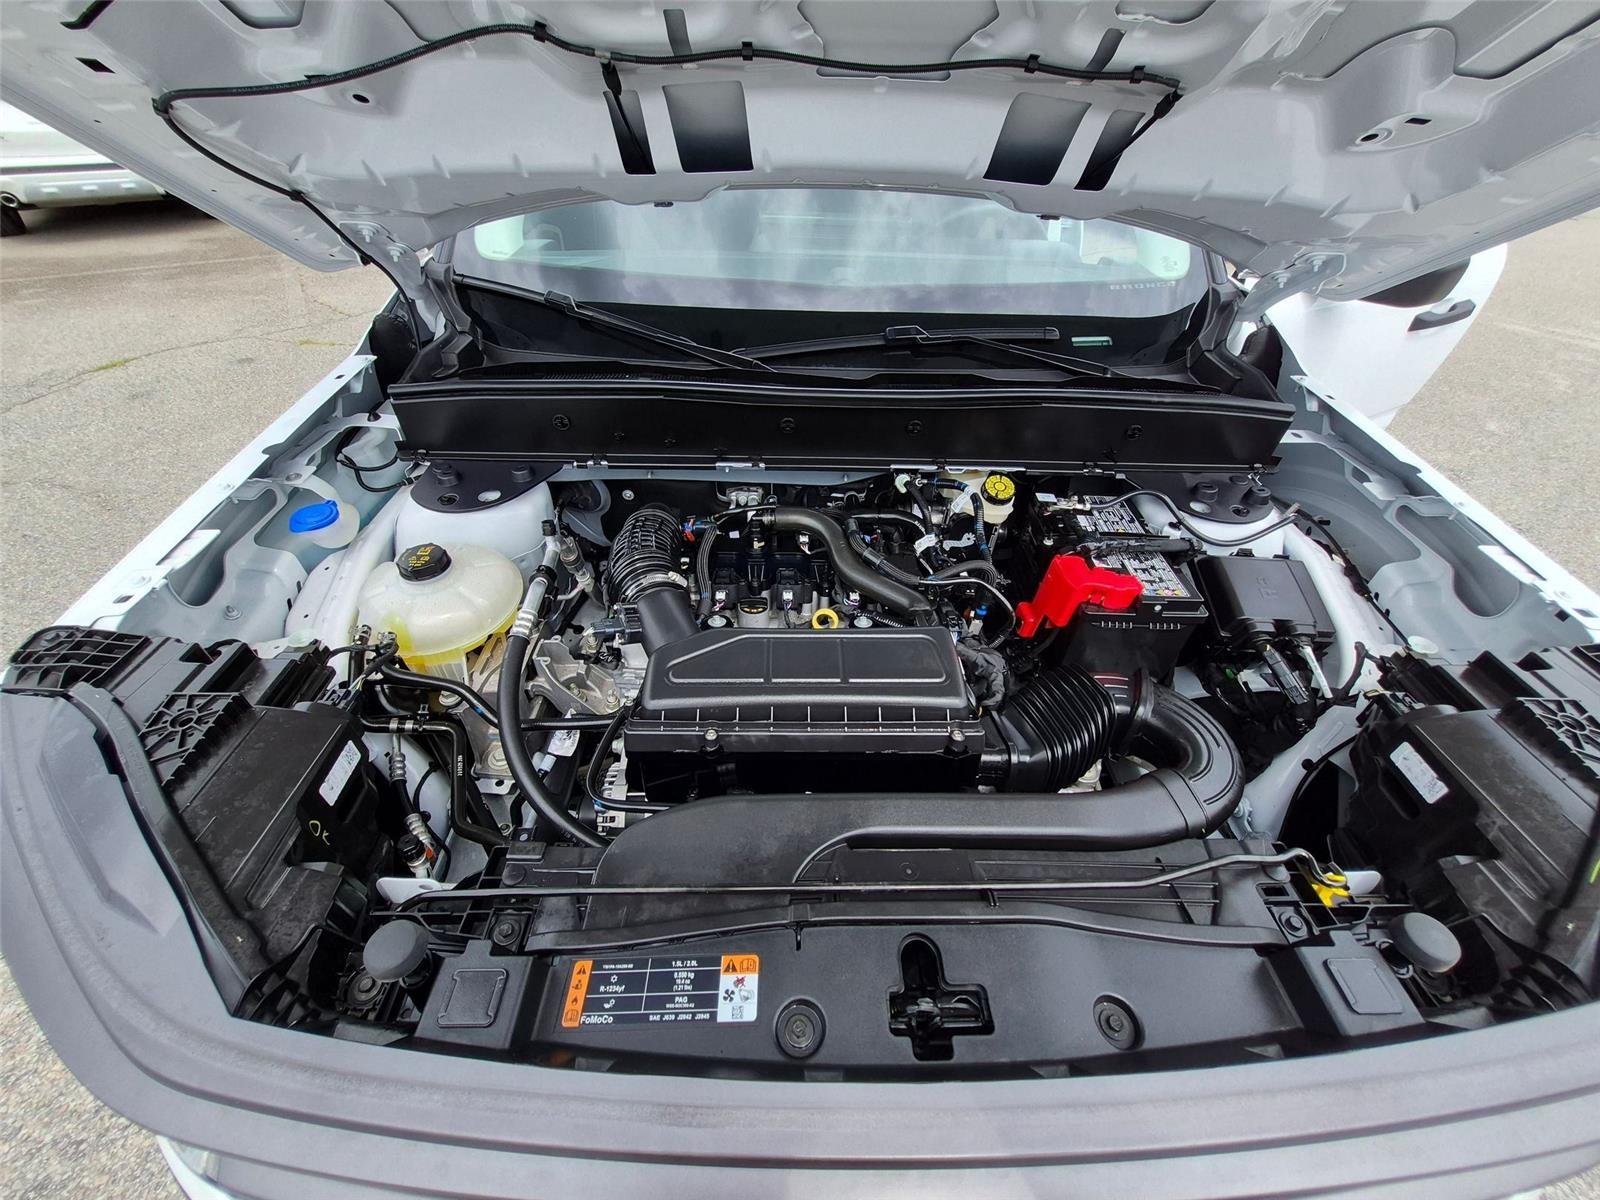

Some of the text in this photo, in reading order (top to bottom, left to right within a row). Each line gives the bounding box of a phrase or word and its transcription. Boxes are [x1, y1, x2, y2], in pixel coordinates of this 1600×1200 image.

[1109, 281, 1176, 290] BRONCO
[599, 985, 625, 993] R-1234yf
[580, 1015, 614, 1024] FoMoCo
